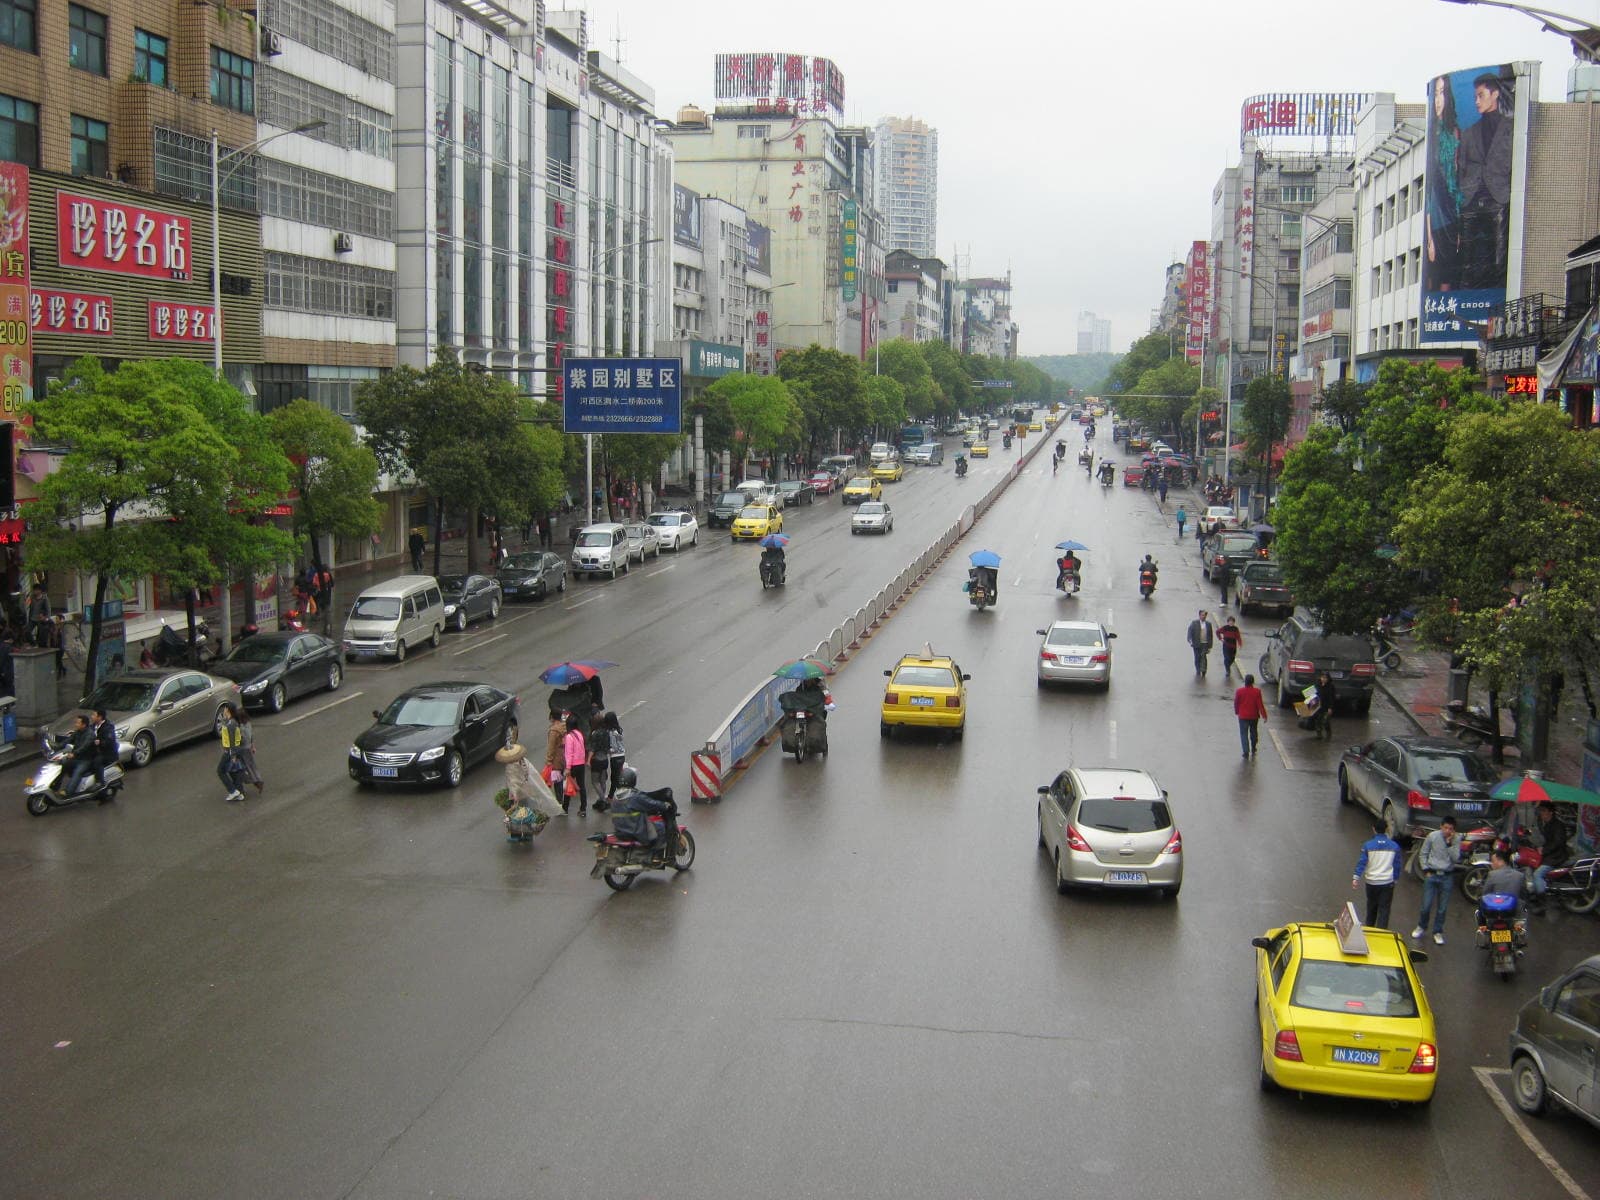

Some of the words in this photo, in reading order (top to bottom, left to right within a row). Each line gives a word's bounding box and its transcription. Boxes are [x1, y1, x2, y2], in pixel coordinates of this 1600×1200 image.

[0, 254, 25, 278] 宾
[570, 367, 676, 389] 紫园别墅区
[1348, 1049, 1380, 1064] X2096
